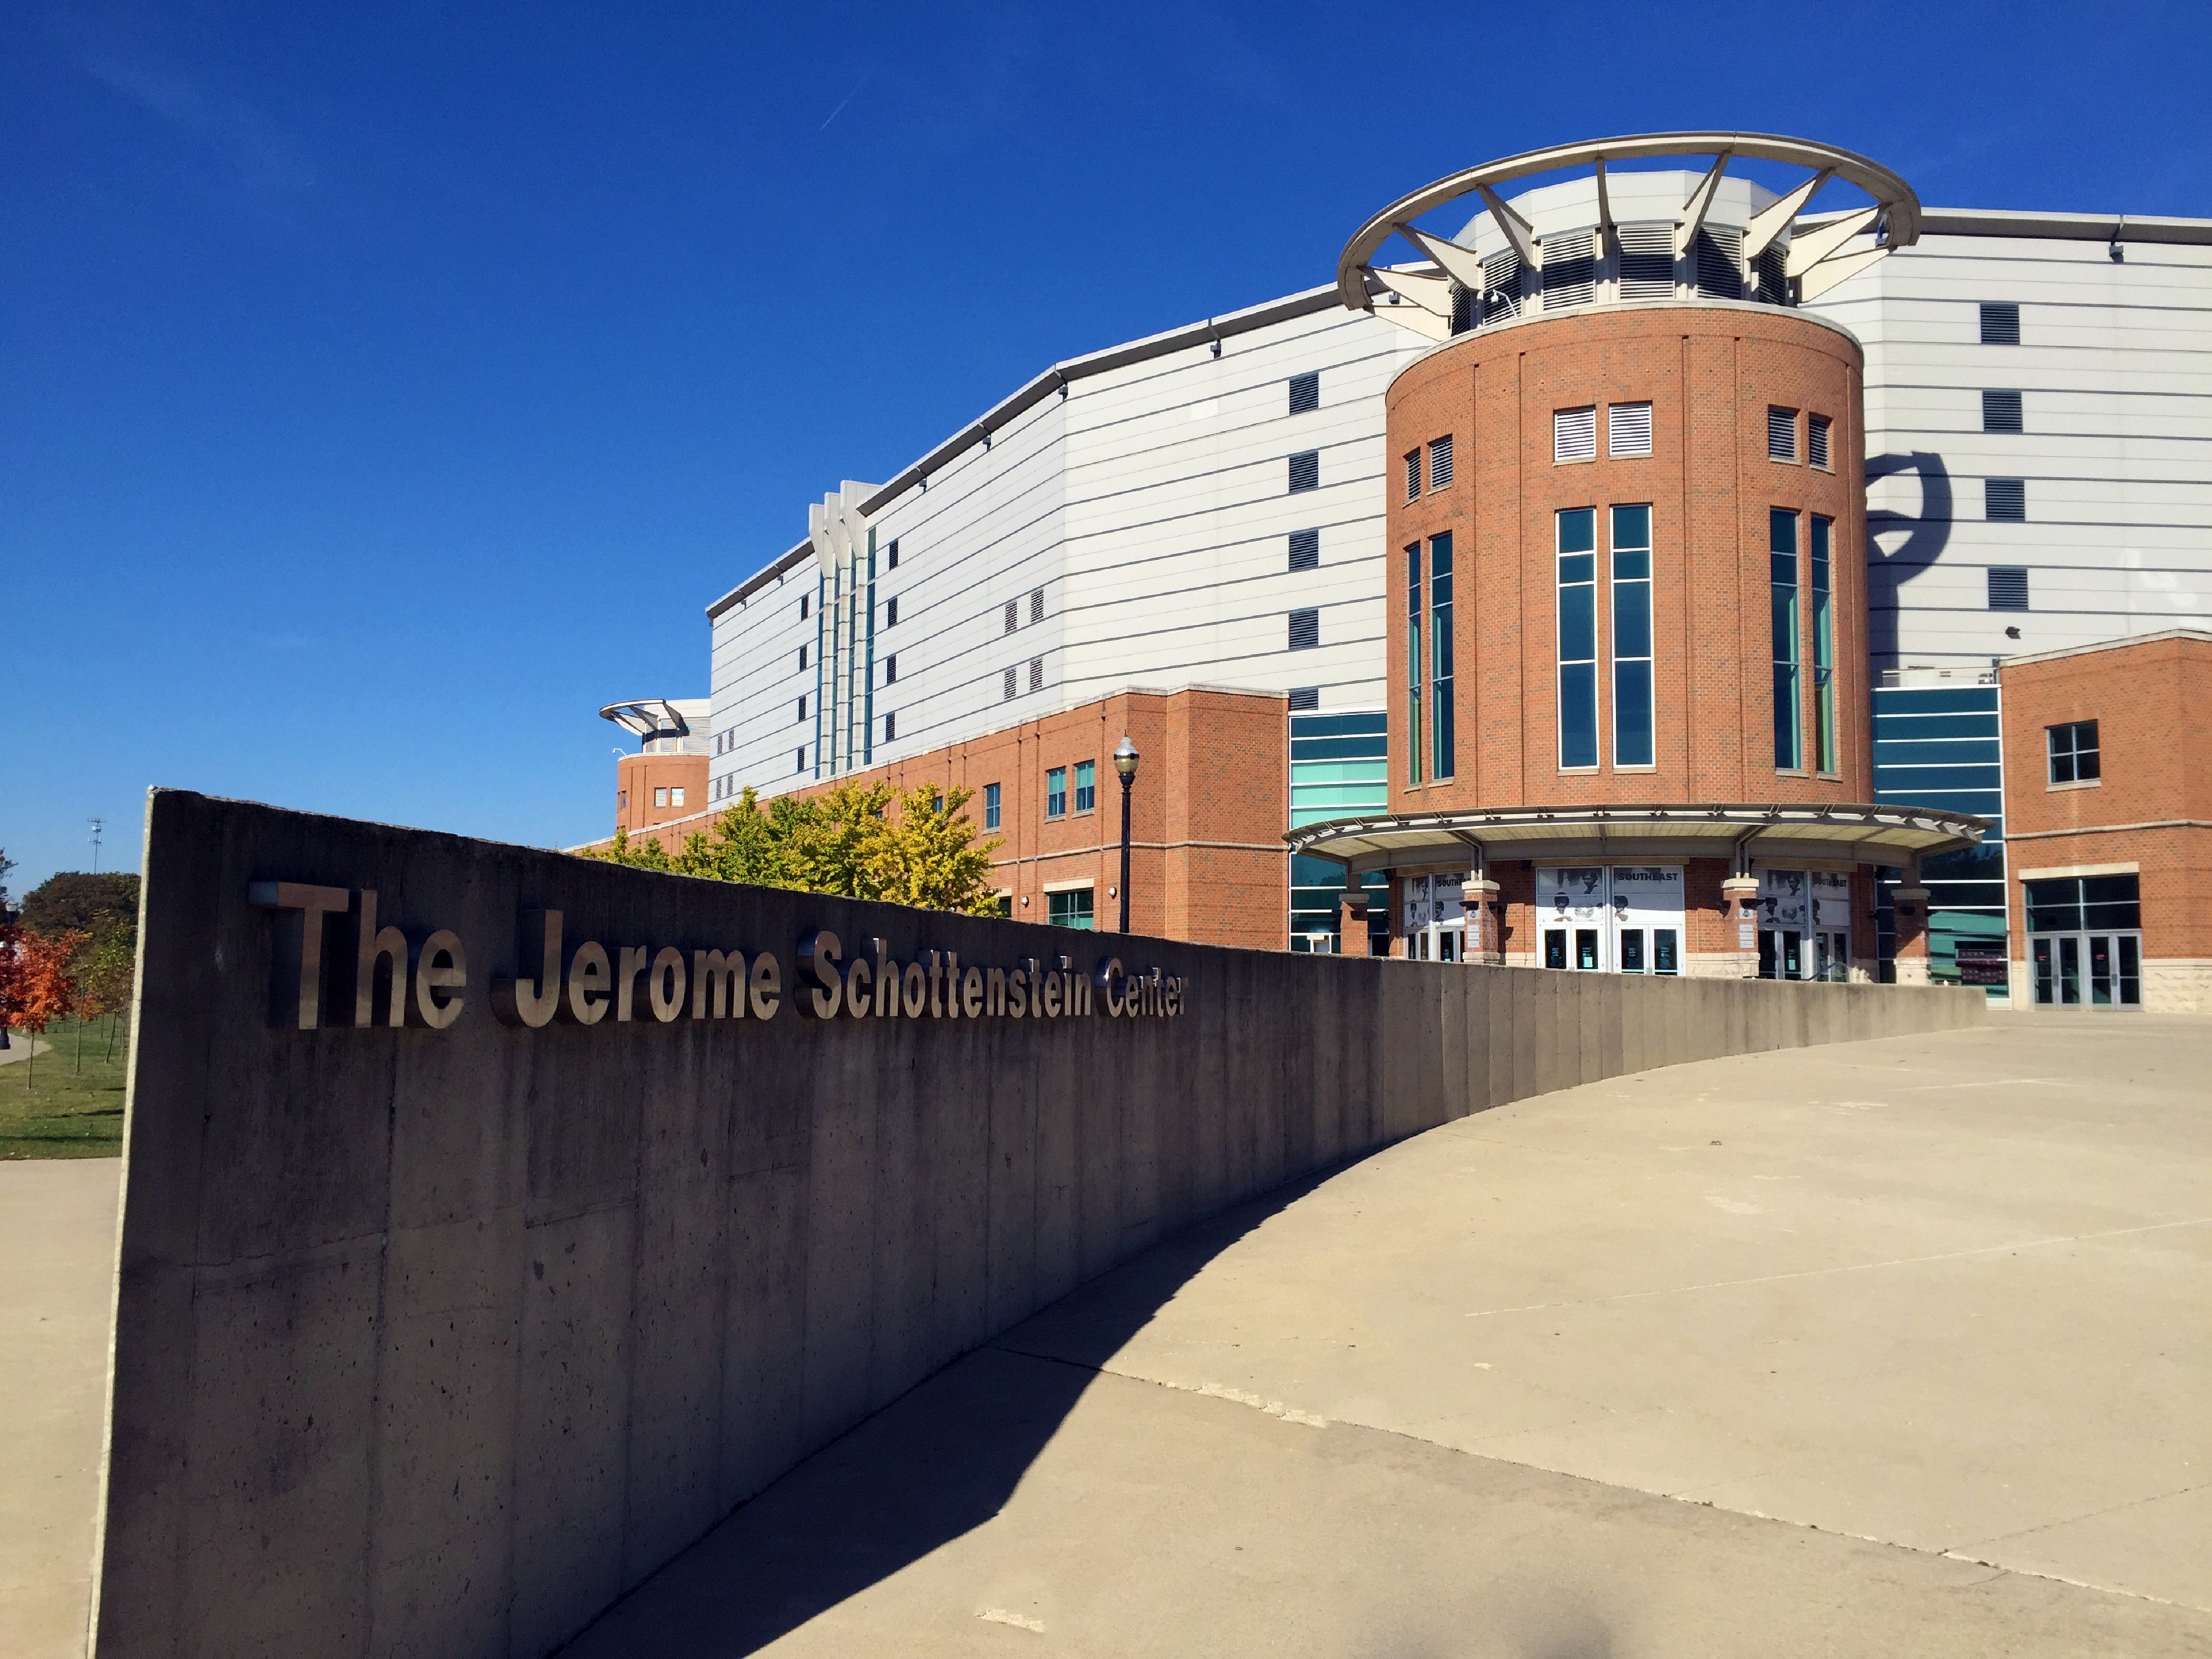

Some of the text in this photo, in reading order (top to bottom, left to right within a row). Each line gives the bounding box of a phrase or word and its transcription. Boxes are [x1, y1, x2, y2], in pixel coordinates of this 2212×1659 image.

[1618, 873, 1678, 881] SOUTHEAST
[1437, 878, 1471, 887] SOUTHE
[275, 881, 1188, 1030] The Jerome Schottenstein Center
